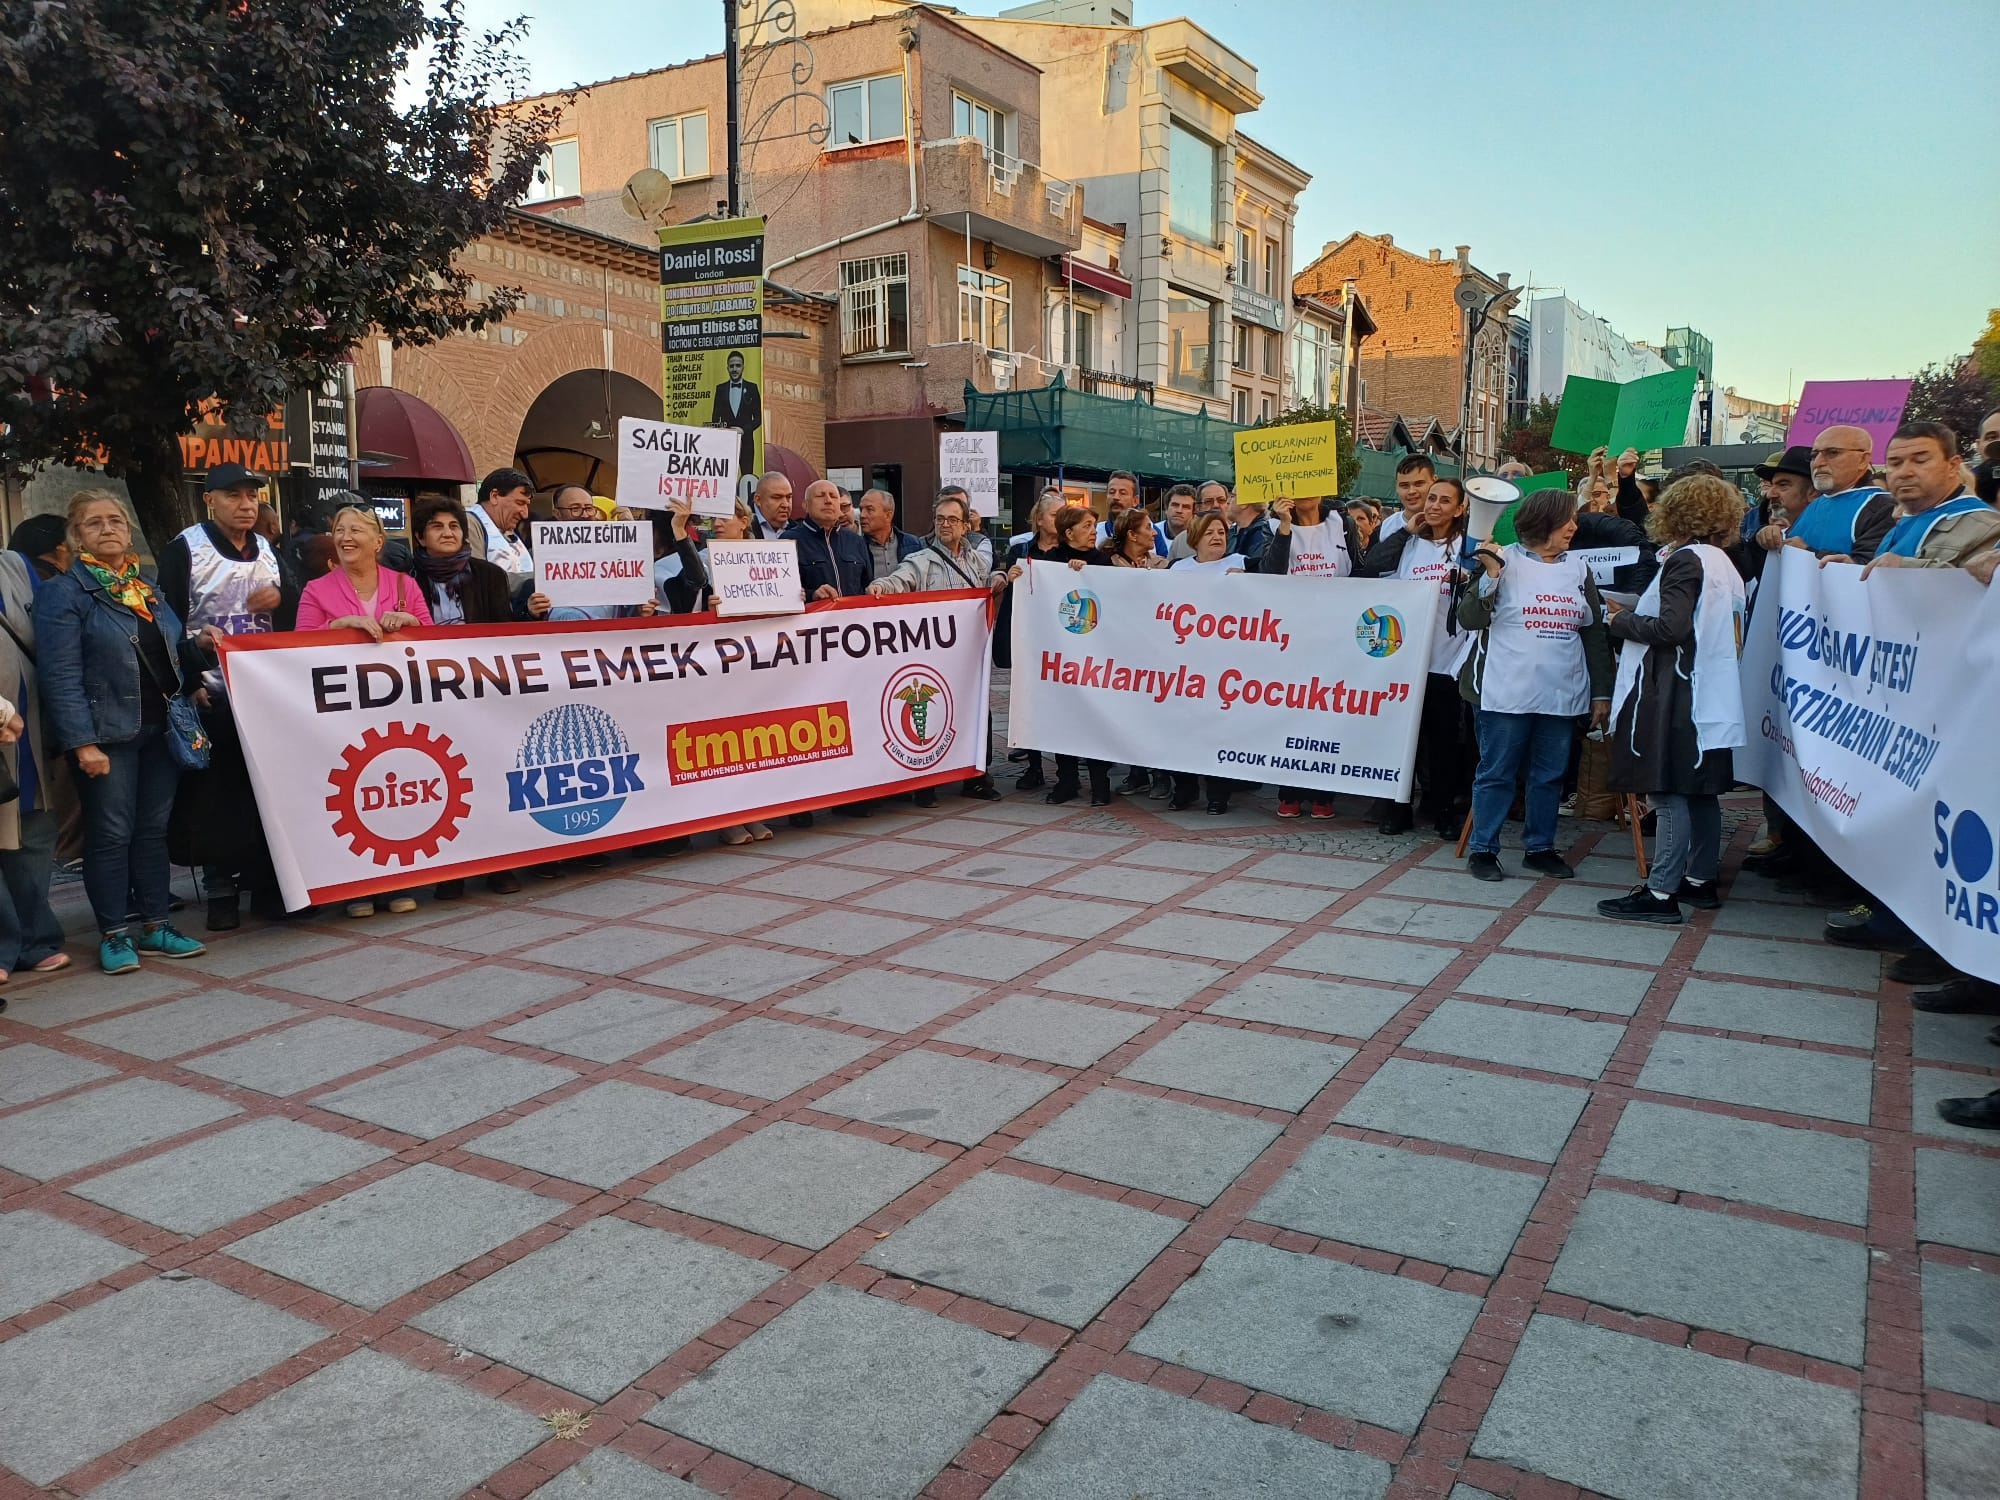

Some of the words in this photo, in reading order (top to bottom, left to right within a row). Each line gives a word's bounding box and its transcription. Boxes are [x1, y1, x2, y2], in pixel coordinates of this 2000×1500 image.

[664, 249, 710, 271] Daniel
[714, 244, 755, 265] Rossi
[695, 270, 724, 279] London
[668, 323, 699, 337] Takım
[702, 320, 736, 334] Elbise
[738, 318, 758, 331] Set
[1803, 407, 1901, 424] SUÇLUSUNUZ
[632, 428, 701, 454] SAĞLIK
[1240, 435, 1328, 456] ÇOCUKLARINIZIN
[178, 436, 289, 471] PANYA!!
[667, 453, 729, 477] BAKANI
[1269, 450, 1314, 465] YÜZÜNE
[658, 473, 718, 498] İSTİFA!
[1243, 474, 1271, 485] NASIL
[540, 527, 592, 545] PARASIZ
[594, 523, 637, 544] EĞİTİM
[544, 561, 596, 581] PARASIZ
[600, 558, 644, 579] SAĞLIK
[713, 551, 756, 566] SAĞLIKTA
[1535, 594, 1577, 606] ÇOCUK,
[311, 646, 549, 714] EDİRNE
[560, 638, 708, 690] EMEK
[714, 614, 957, 674] PLATFORMU
[1040, 650, 1206, 703] Haklarıyla
[1217, 668, 1410, 717] Çocuktur”
[671, 706, 846, 771] tmmob
[1285, 736, 1341, 754] EDİRNE
[675, 771, 699, 782] TÜRK
[701, 763, 744, 778] MÜHENDİS
[746, 762, 757, 770] VE
[759, 757, 786, 769] MİMAR
[787, 752, 820, 764] ODALARI
[821, 745, 849, 757] BİRLİĞİ
[888, 741, 905, 761] TÜRK
[906, 752, 936, 766] TABİPLERİ
[1217, 749, 1267, 767] ÇOCUK
[1270, 756, 1336, 775] HAKLARI
[360, 771, 442, 812] DİSK
[505, 753, 645, 812] KESK
[562, 809, 600, 831] 1995
[1934, 800, 2000, 890] SO
